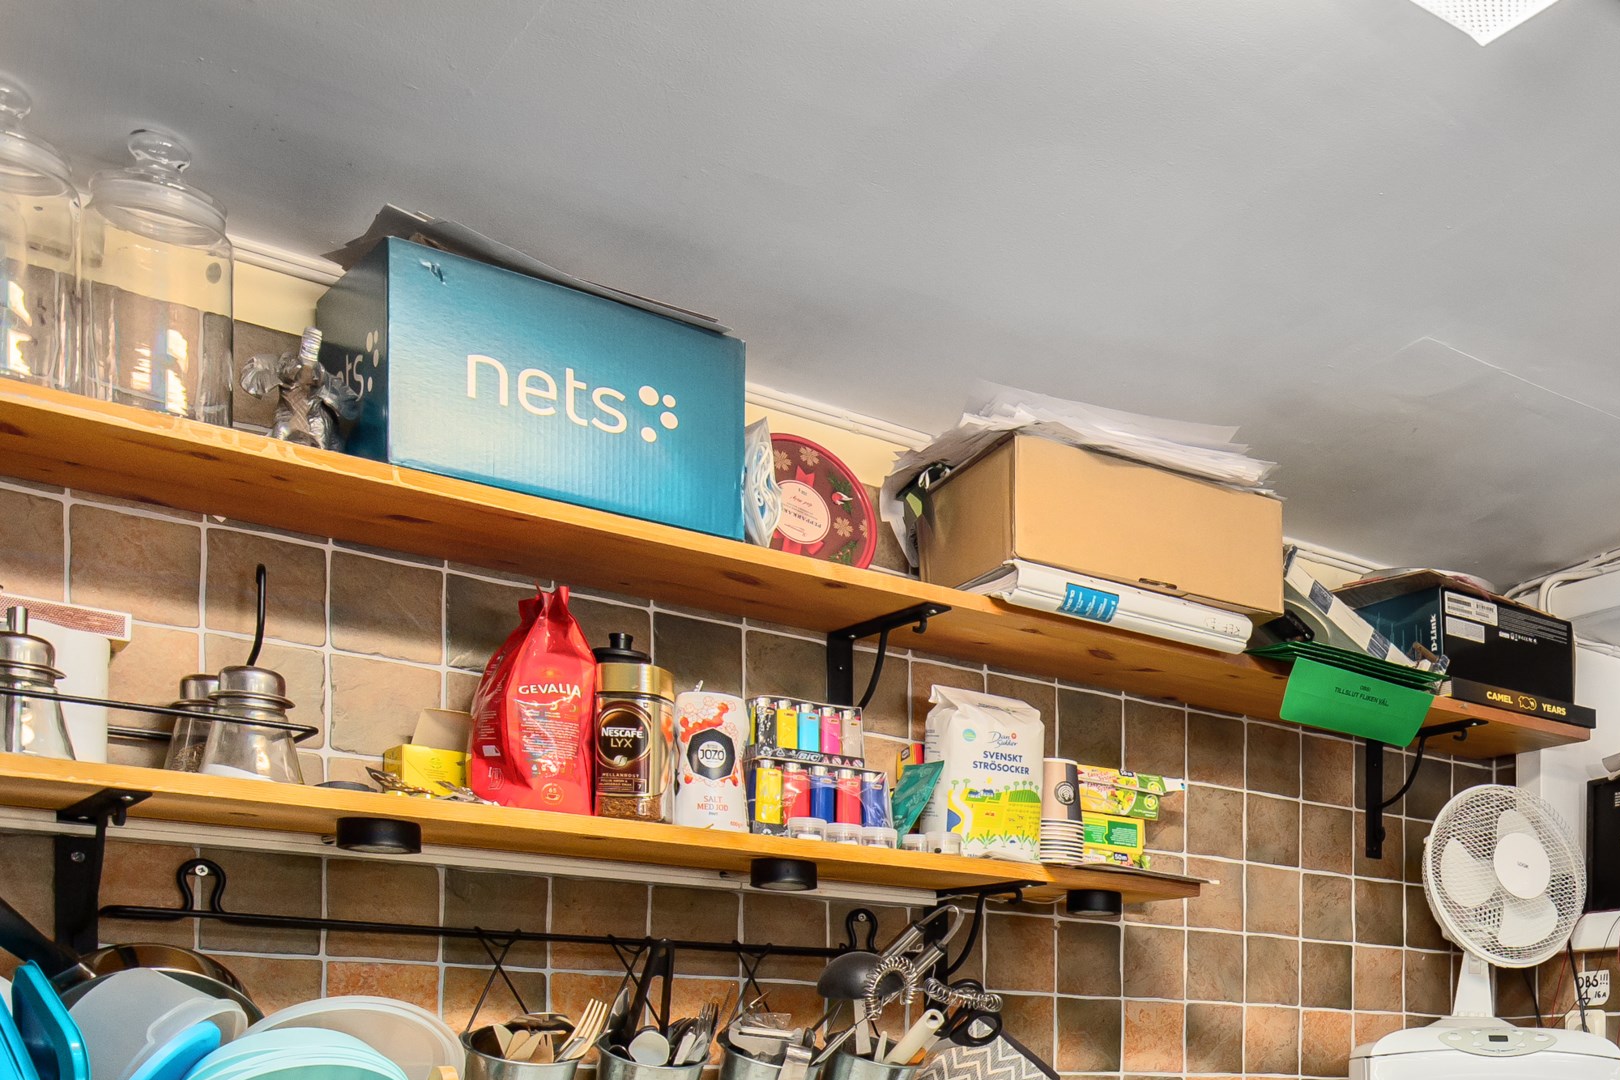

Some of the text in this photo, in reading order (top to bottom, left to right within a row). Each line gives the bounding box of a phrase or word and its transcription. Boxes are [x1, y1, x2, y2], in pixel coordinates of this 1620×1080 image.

[466, 354, 628, 434] nets
[783, 508, 822, 528] PEPPARKAK
[1430, 613, 1438, 652] D-Link
[518, 683, 581, 698] GEVALIA
[1335, 686, 1359, 698] TILLSLUT
[1486, 691, 1513, 704] CAMEL
[1542, 703, 1566, 716] YEARS
[601, 726, 644, 738] NESCAFÉ
[610, 738, 632, 748] LYX
[700, 749, 725, 760] JOZO
[983, 750, 1023, 763] SVENSKT
[972, 760, 1030, 775] STRÖSOCKER
